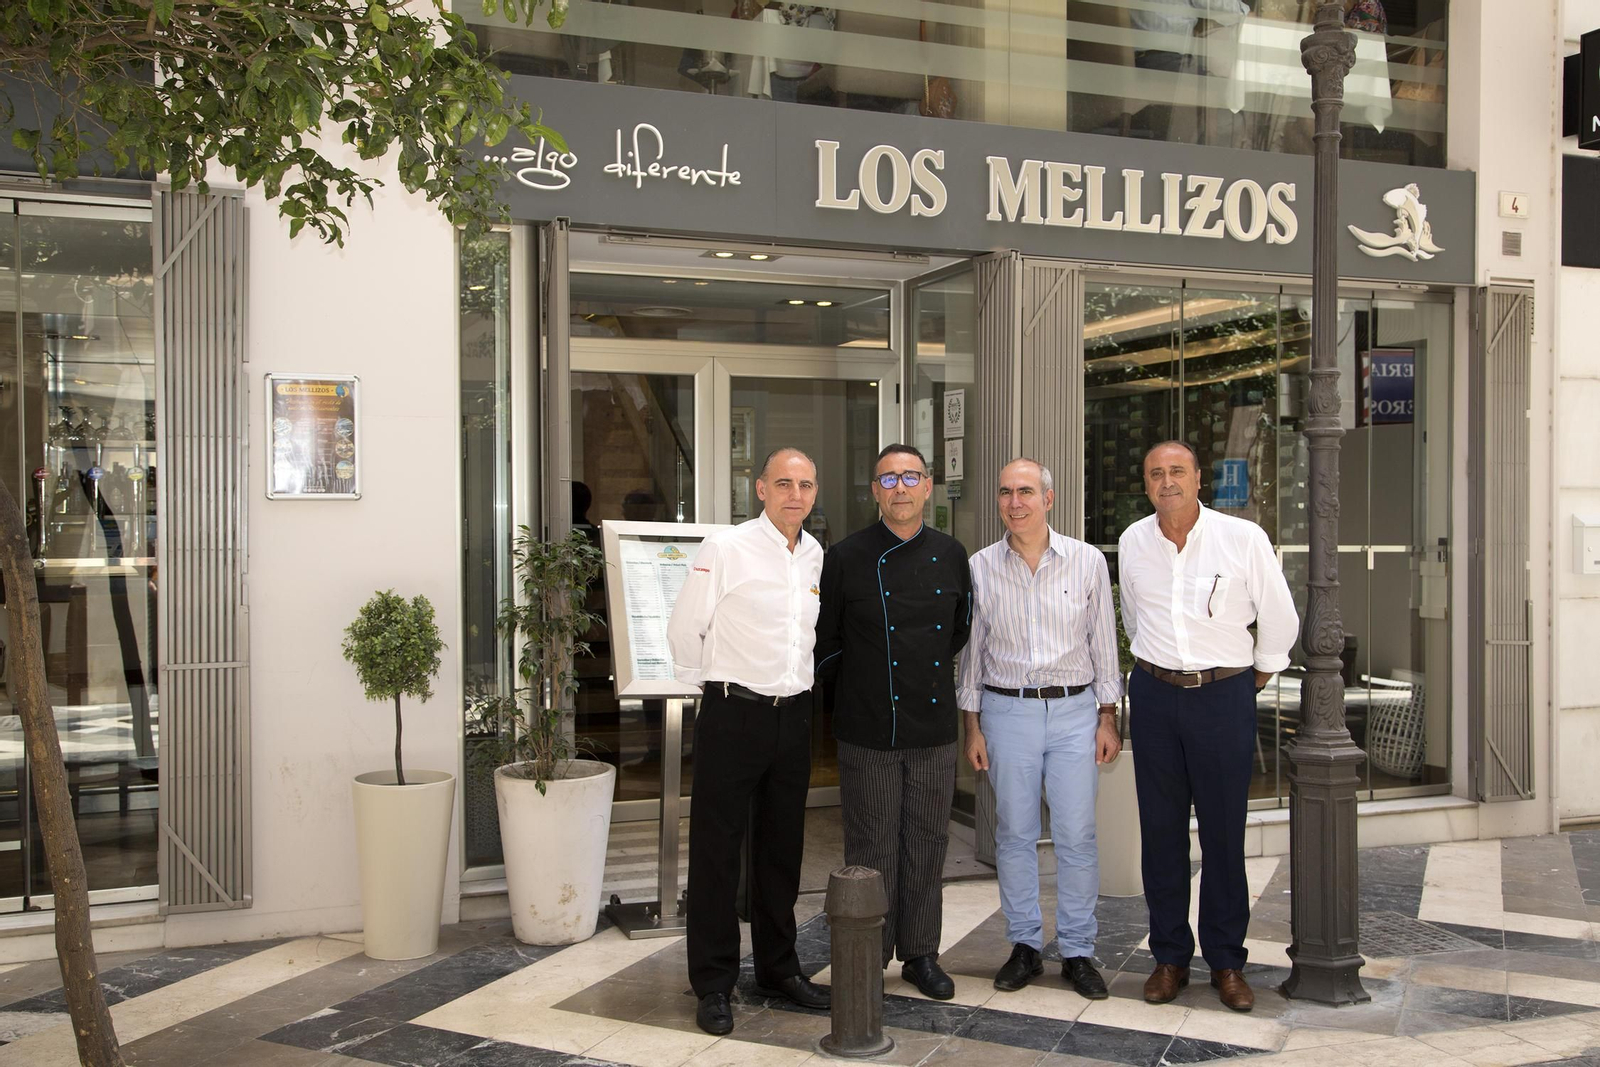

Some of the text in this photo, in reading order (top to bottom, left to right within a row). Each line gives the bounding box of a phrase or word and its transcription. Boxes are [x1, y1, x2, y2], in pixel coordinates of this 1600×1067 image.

[603, 123, 742, 189] diferente
[814, 139, 1298, 245] LOS MELLIZOS
[1511, 197, 1519, 213] 4
